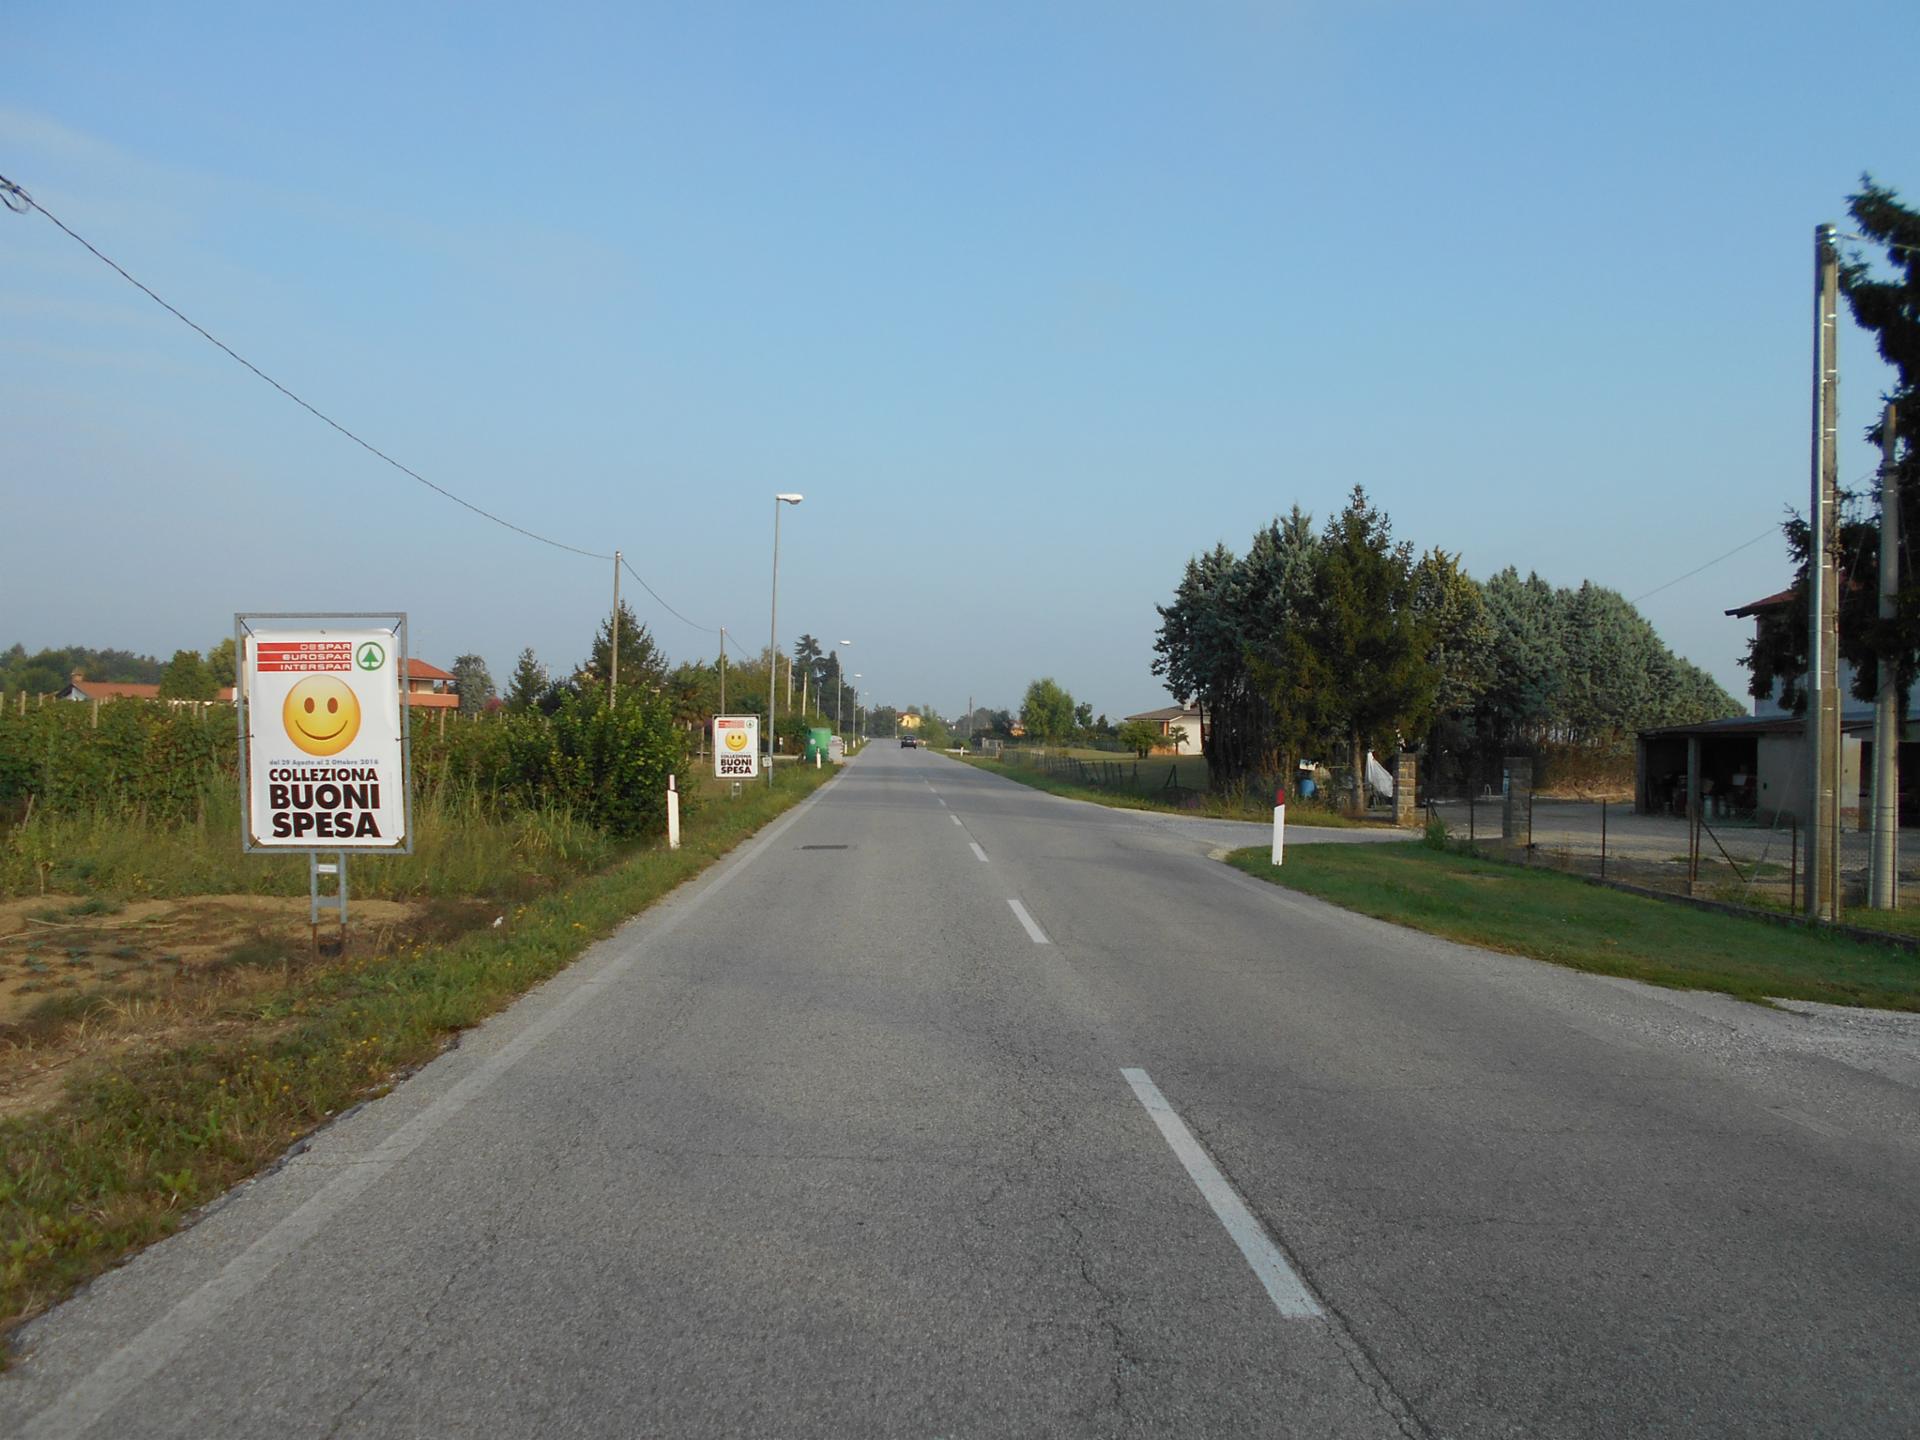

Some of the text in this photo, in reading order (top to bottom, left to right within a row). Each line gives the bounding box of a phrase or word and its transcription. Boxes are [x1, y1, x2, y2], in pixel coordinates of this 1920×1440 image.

[282, 653, 351, 661] EUROSPAR
[269, 769, 379, 781] COLLEZIONA
[721, 766, 752, 774] SPESA
[269, 784, 380, 809] BUONI
[272, 812, 382, 838] SPESA
